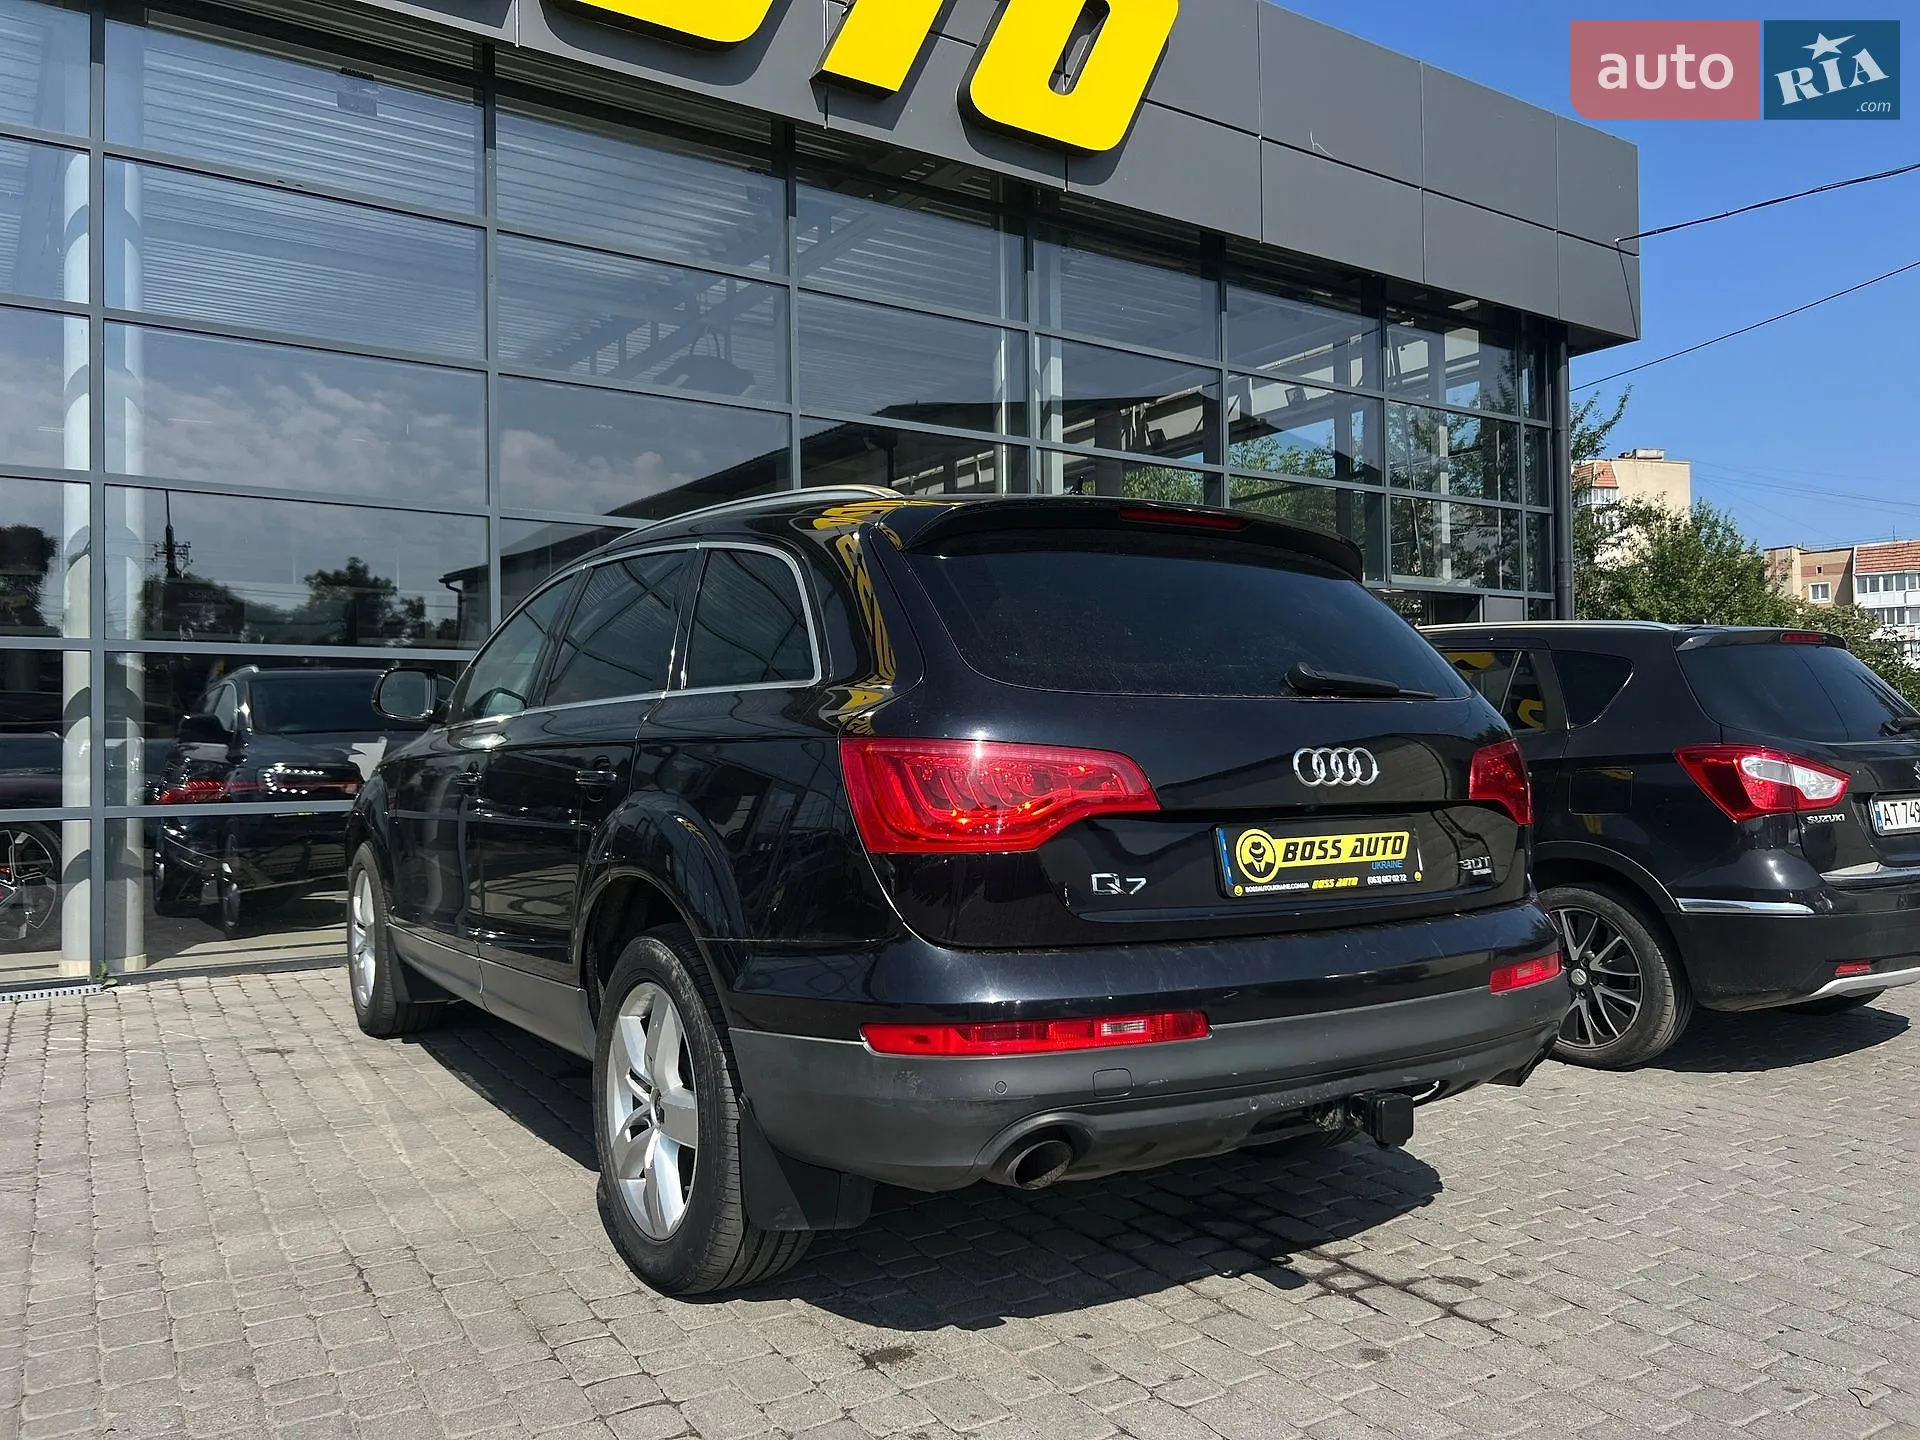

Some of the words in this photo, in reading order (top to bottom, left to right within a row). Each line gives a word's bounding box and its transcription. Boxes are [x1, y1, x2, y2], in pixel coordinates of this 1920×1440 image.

[1805, 813, 1846, 824] SUZUKI
[1883, 802, 1899, 826] AT
[1281, 838, 1343, 863] BOSS
[1349, 834, 1405, 859] AUTO
[1371, 860, 1404, 870] UKRAINE
[1090, 872, 1147, 895] Q7
[1312, 878, 1335, 890] BOSS
